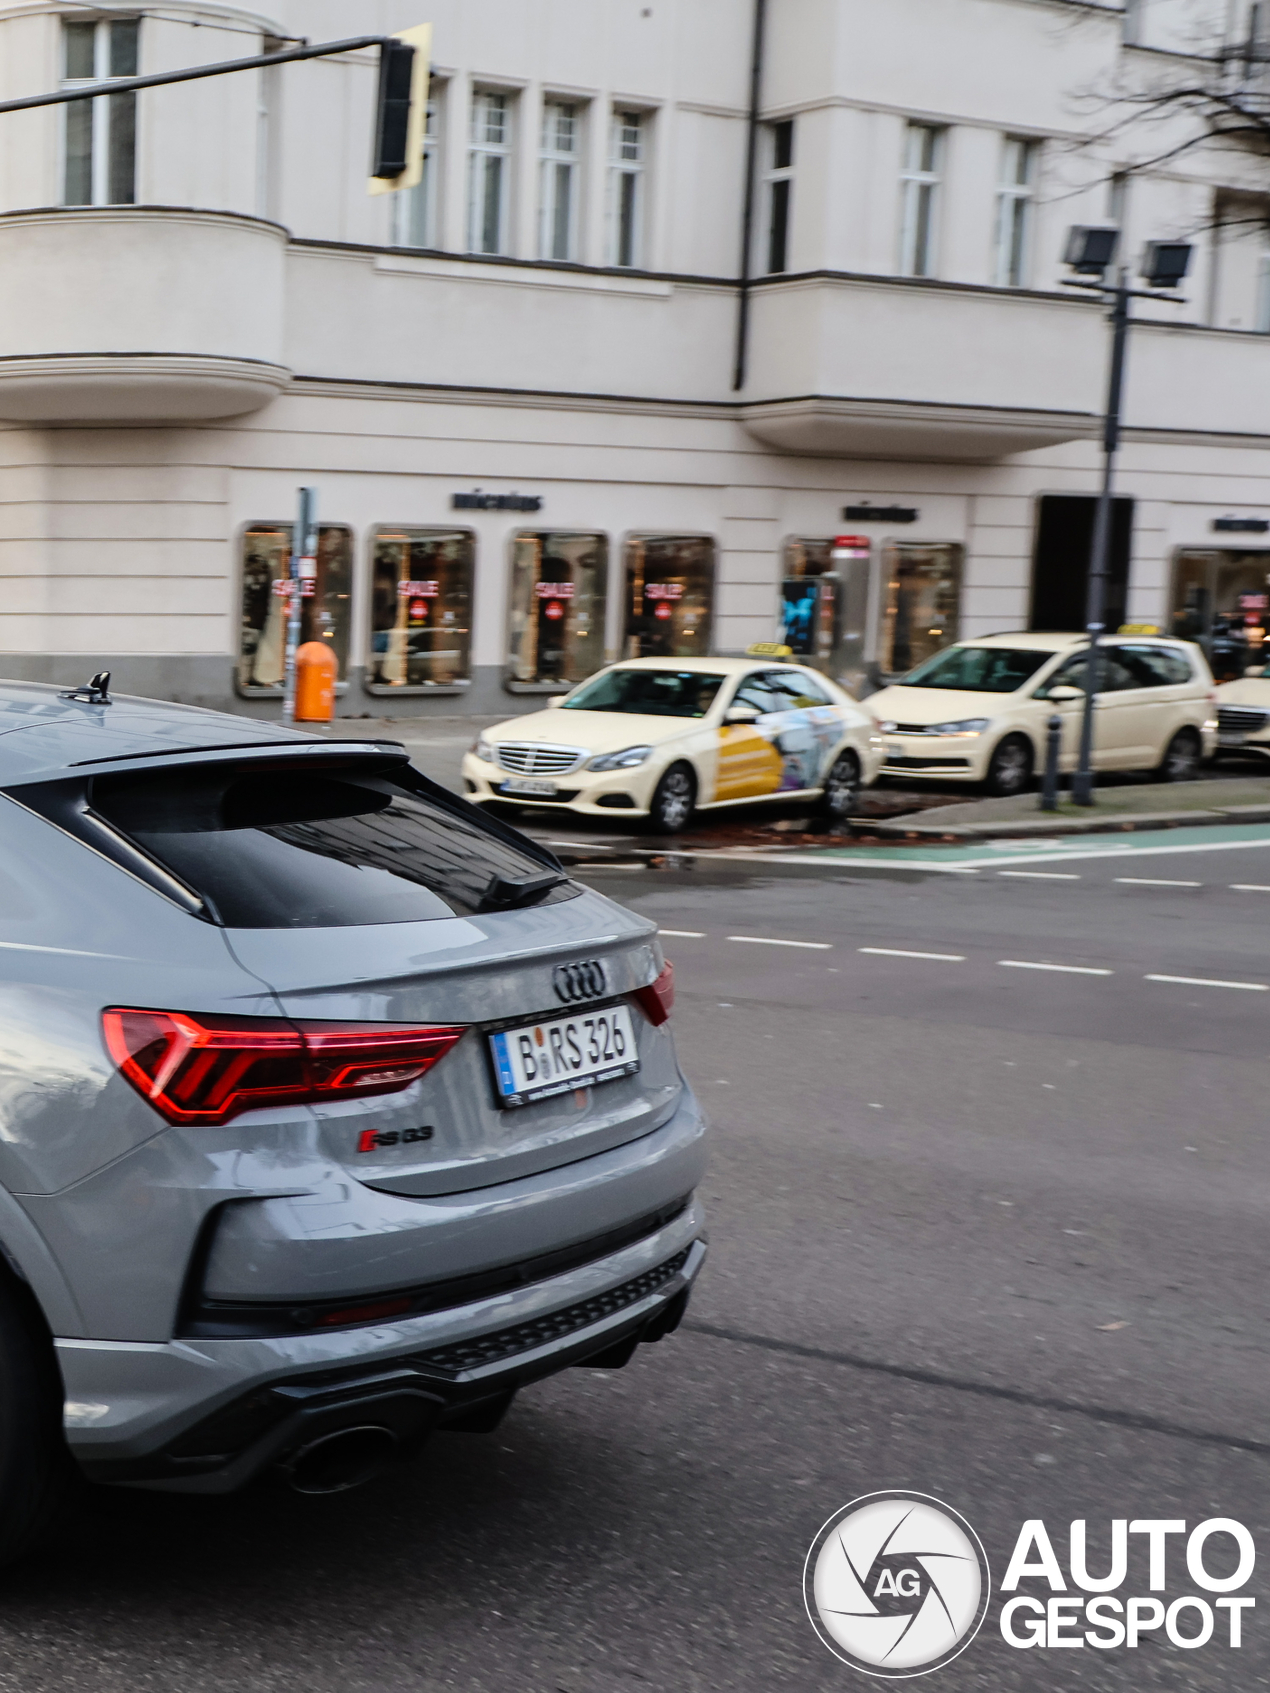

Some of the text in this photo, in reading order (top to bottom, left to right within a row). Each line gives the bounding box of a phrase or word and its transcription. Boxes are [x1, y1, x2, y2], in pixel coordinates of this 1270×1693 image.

[397, 580, 439, 597] SALE
[519, 1014, 626, 1081] B RS 326
